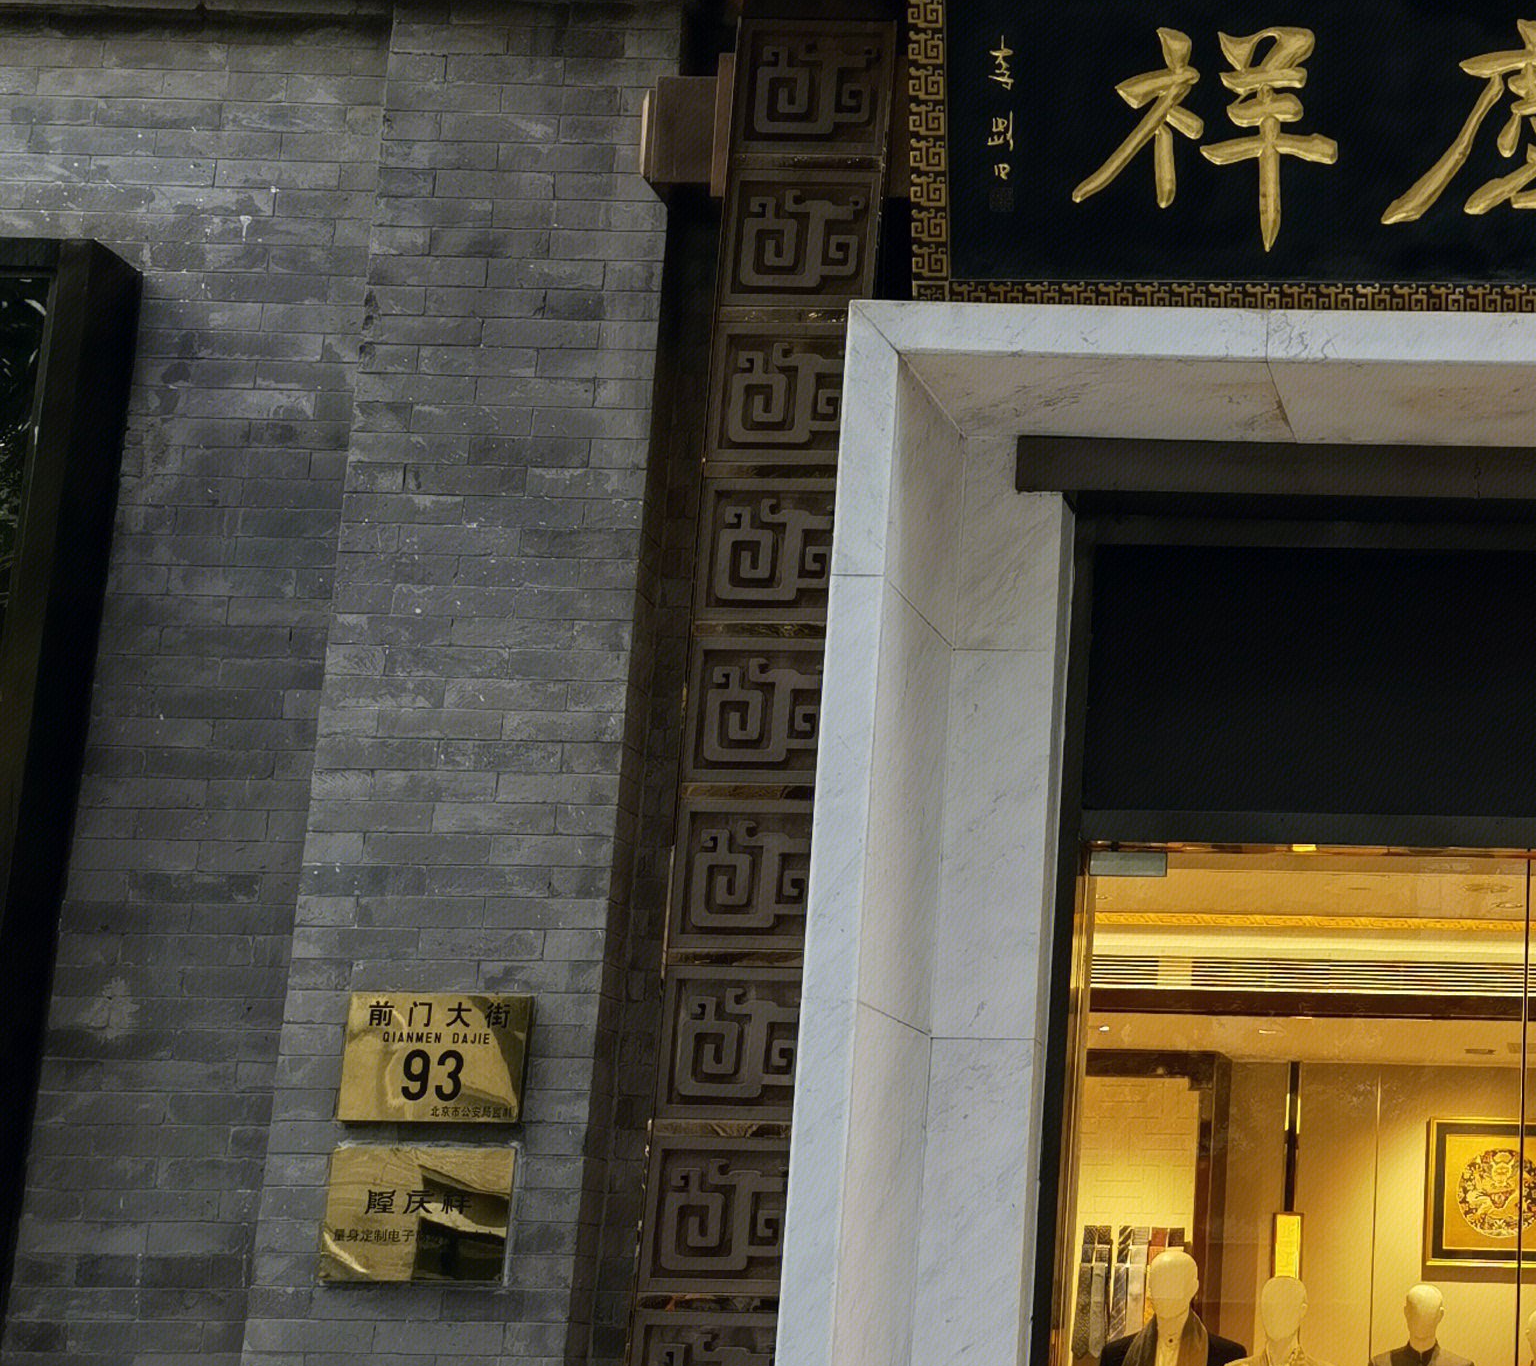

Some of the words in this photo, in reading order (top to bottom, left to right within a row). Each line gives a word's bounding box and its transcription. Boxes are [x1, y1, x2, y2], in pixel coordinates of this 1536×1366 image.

[368, 1000, 511, 1028] 前门大街
[382, 1032, 442, 1044] QIANMEN
[452, 1033, 491, 1045] DAJIE
[401, 1048, 464, 1102] 93
[364, 1189, 472, 1215] 隆庆祥
